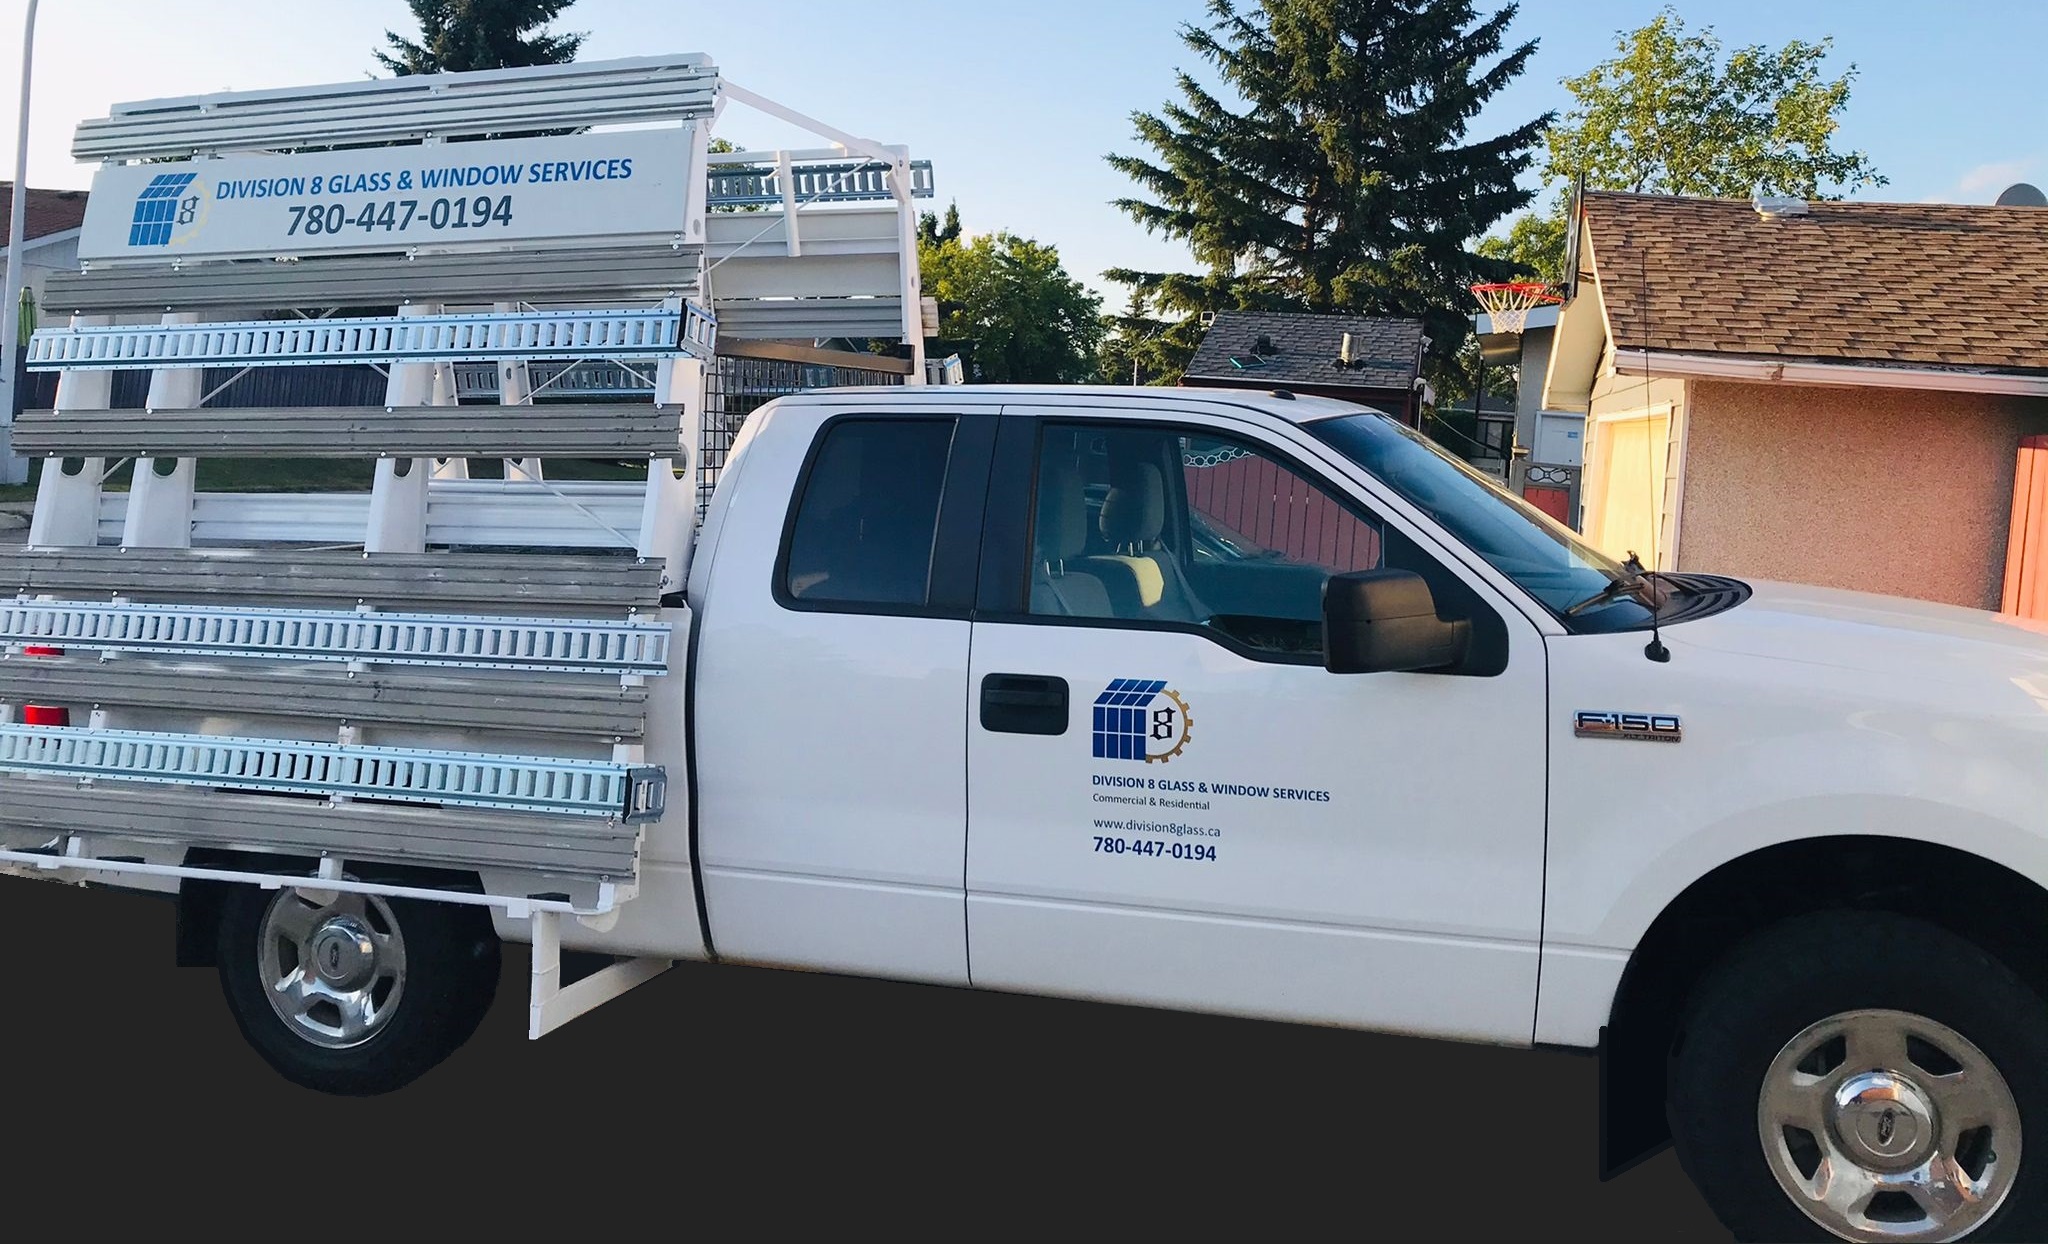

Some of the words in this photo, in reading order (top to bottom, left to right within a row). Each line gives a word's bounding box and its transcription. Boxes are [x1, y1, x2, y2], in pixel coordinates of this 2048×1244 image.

[216, 177, 304, 200] DIVISION
[310, 176, 323, 195] 8
[328, 172, 391, 193] GLASS
[397, 170, 413, 190] &
[421, 164, 523, 188] WINDOW
[528, 158, 633, 182] SERVICES
[287, 195, 513, 236] 780-447-0194
[1150, 707, 1176, 740] 8
[1092, 775, 1145, 789] DIVISION
[1148, 779, 1155, 790] 8
[1158, 780, 1195, 793] GLASS
[1198, 783, 1208, 793] &
[1211, 783, 1269, 798] WINDOW
[1273, 788, 1330, 802] SERVICES
[1093, 793, 1147, 806] Commercial
[1149, 798, 1157, 806] &
[1159, 798, 1210, 810] Residential
[1093, 820, 1221, 837] www.division8glass.ca
[1093, 836, 1217, 862] 780-447-0194
